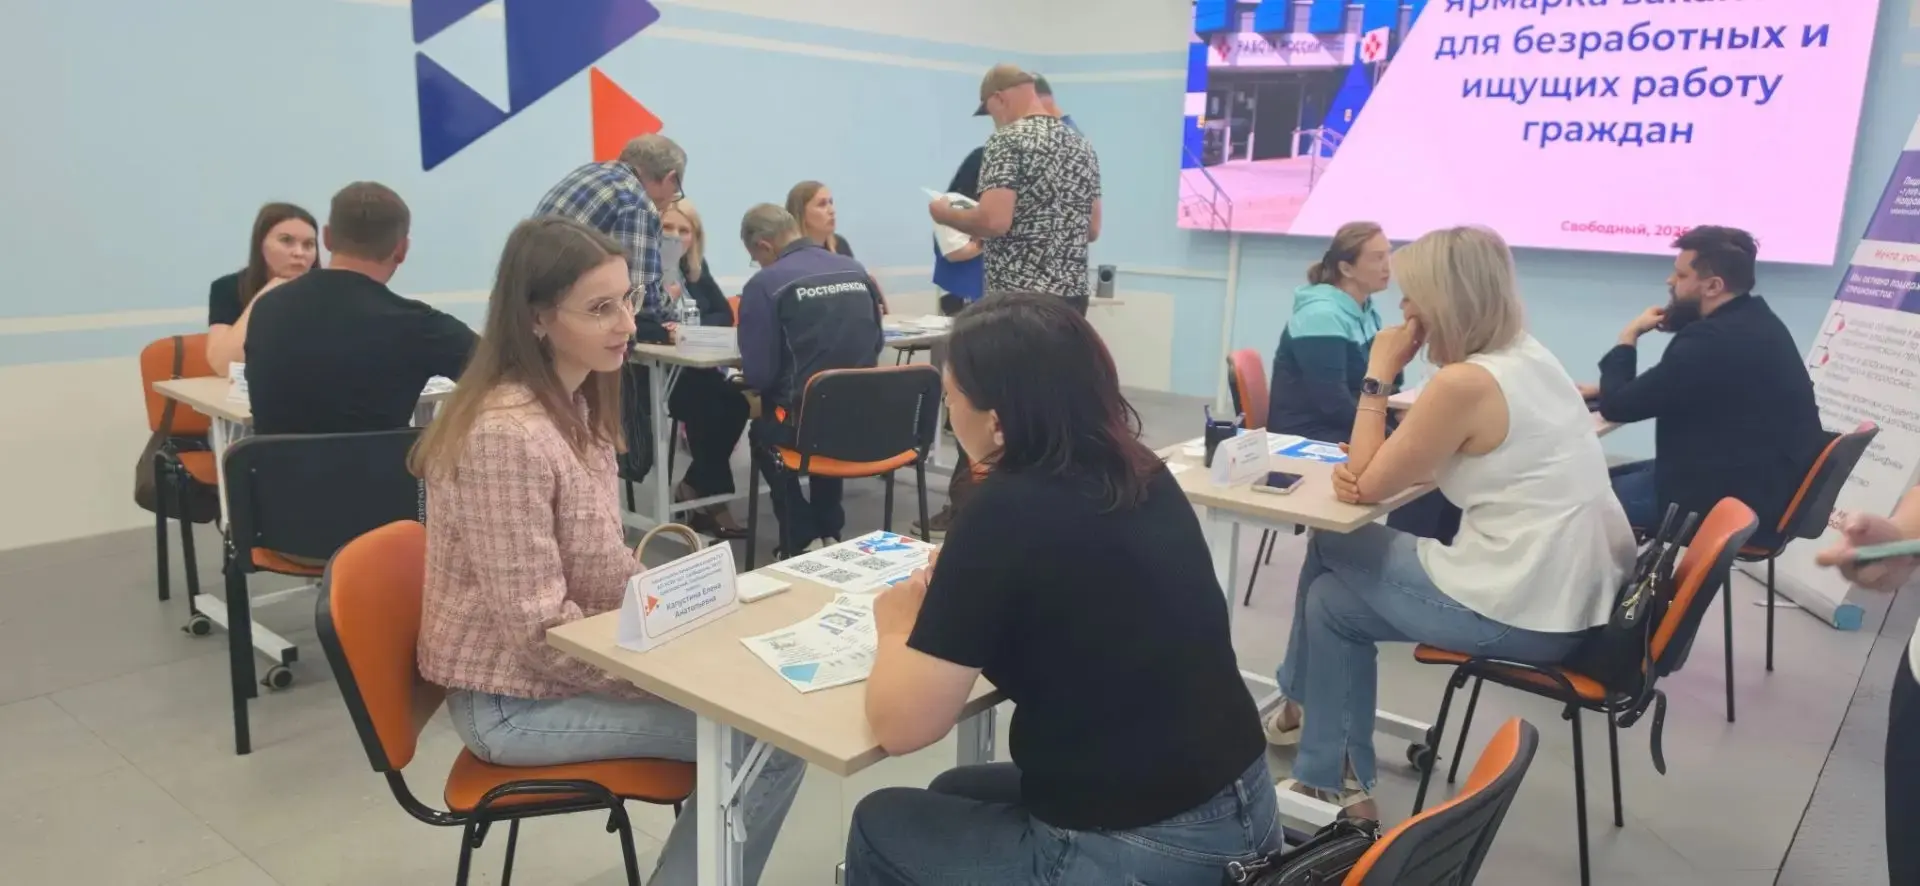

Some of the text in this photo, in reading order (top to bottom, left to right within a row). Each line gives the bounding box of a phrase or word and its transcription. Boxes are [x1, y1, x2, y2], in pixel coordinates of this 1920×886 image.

[1434, 20, 1830, 60] для безработных и
[1461, 66, 1784, 105] ищущих работу
[1523, 121, 1693, 148] граждан
[1561, 220, 1650, 237] Свободный,
[796, 281, 868, 301] Ростелеком
